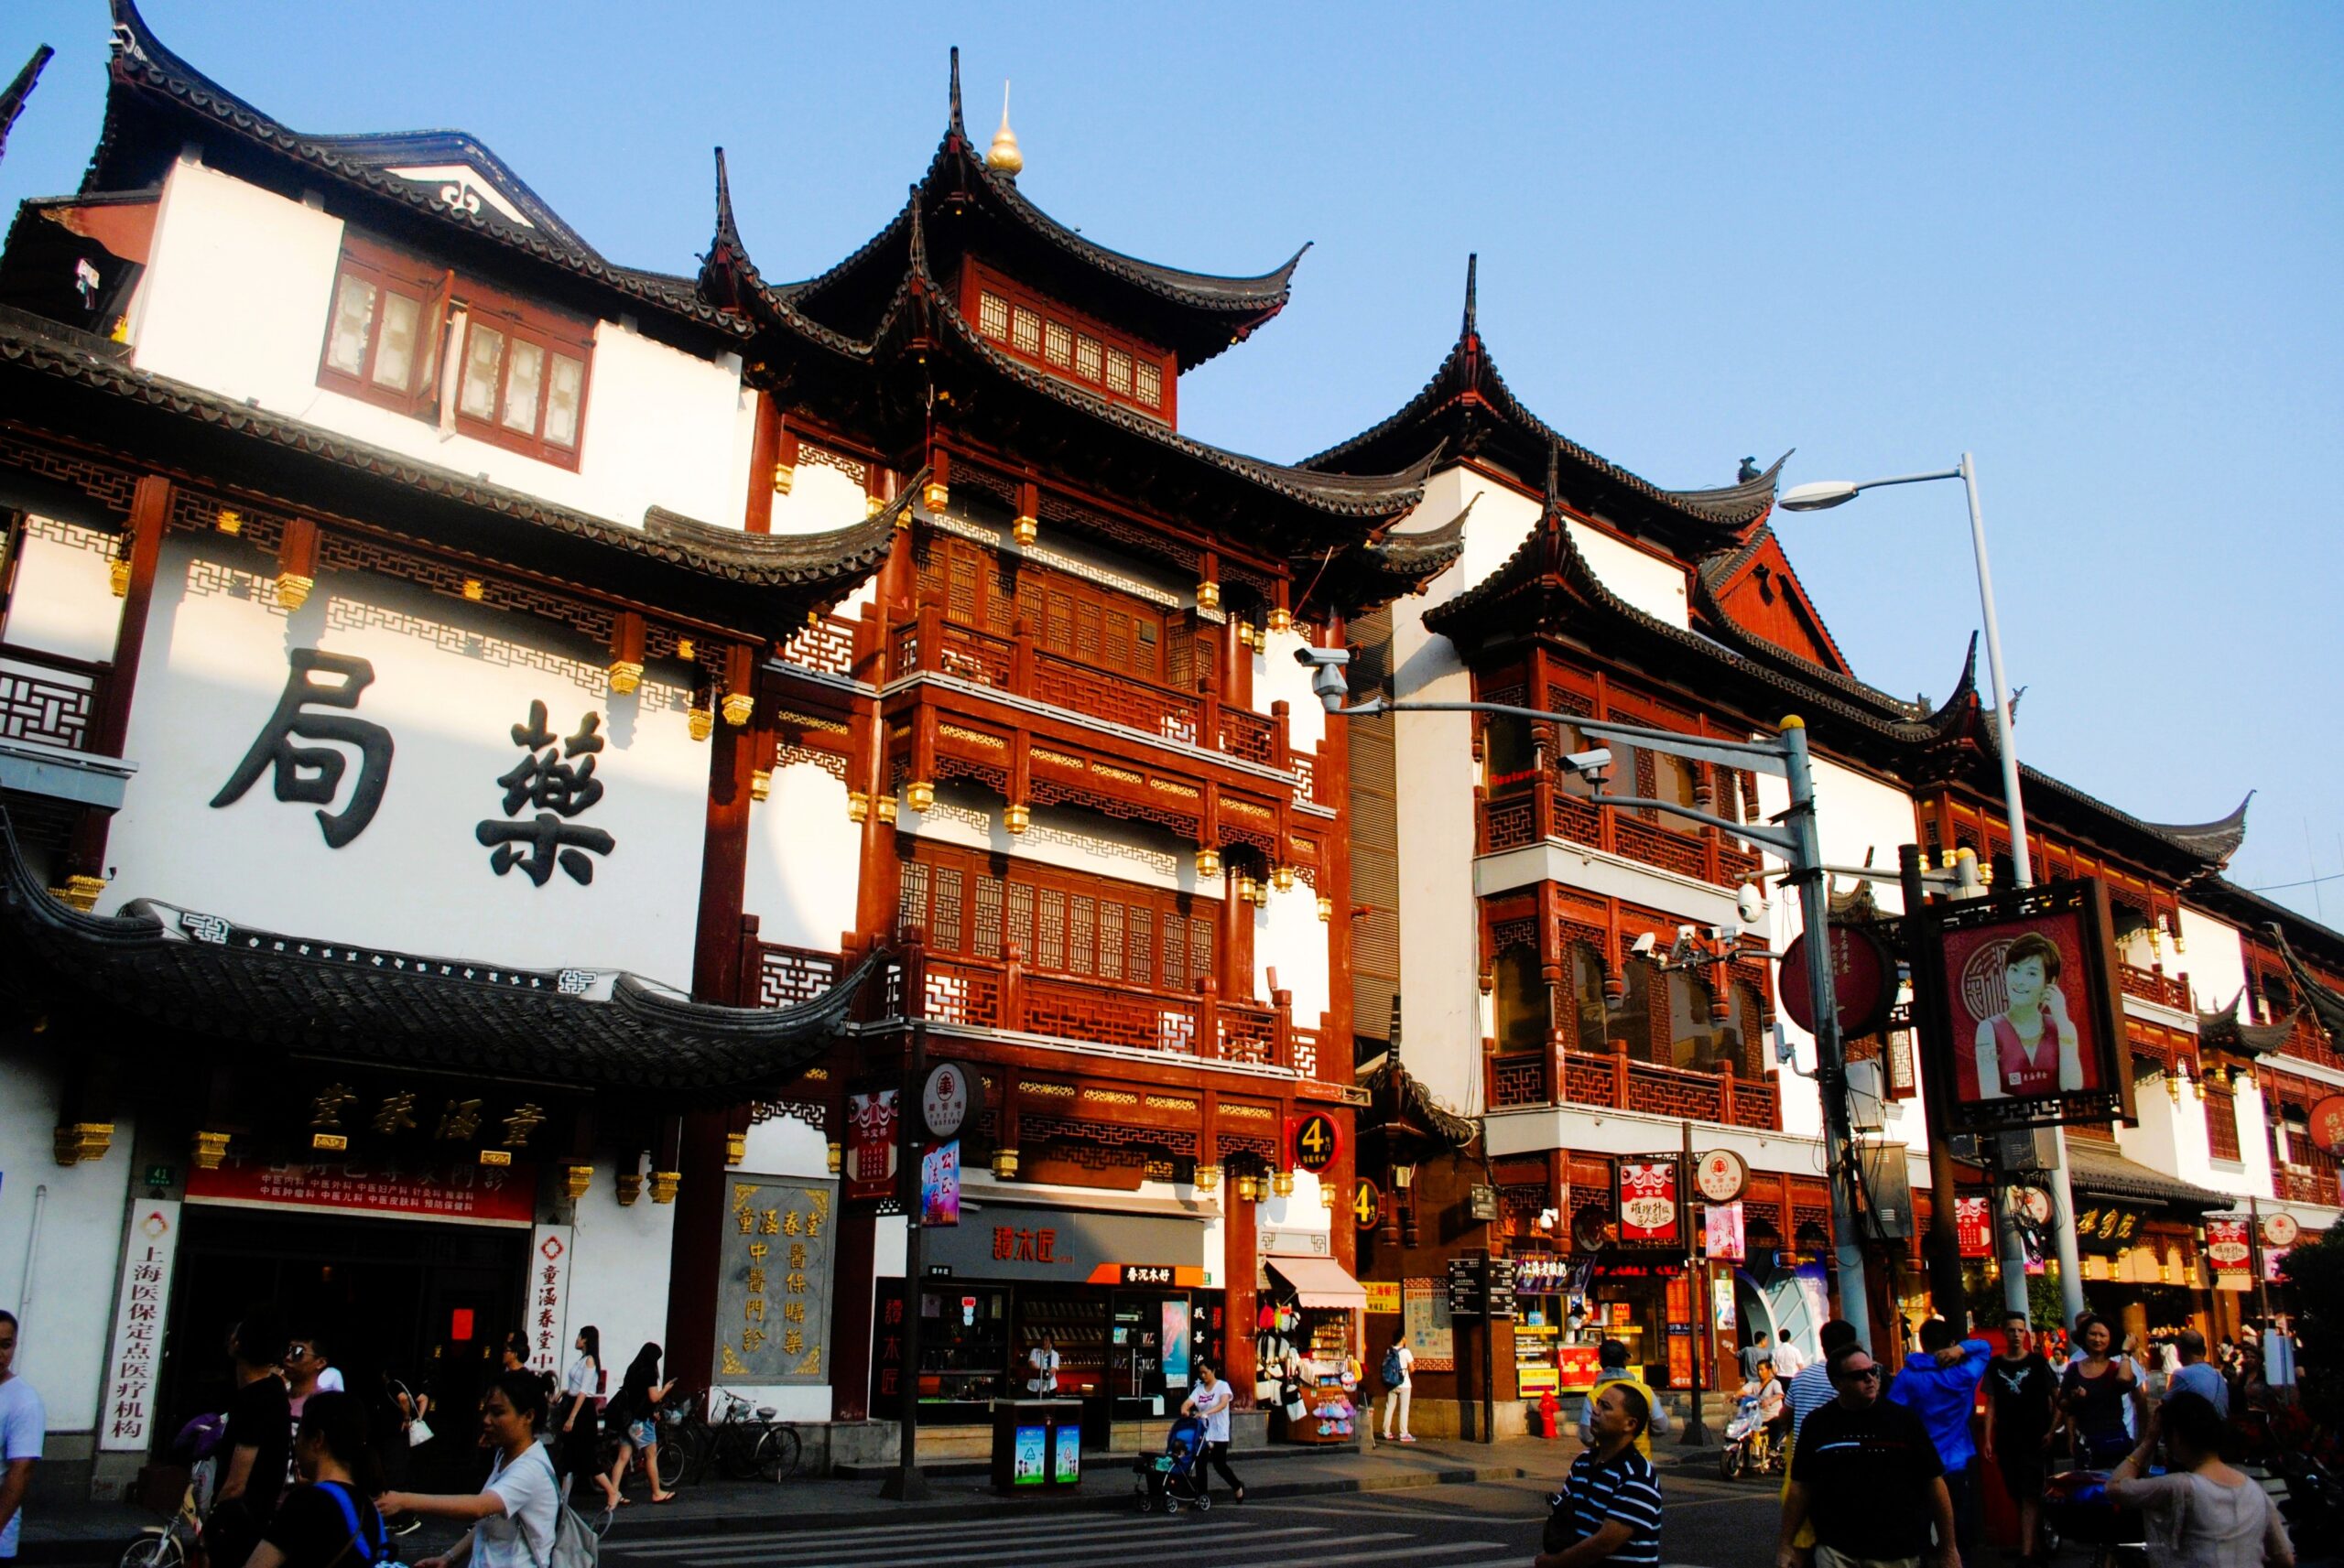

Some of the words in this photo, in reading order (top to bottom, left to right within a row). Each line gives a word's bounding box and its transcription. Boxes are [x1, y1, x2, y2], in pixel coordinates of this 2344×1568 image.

[1302, 1119, 1324, 1152] 4
[154, 1167, 167, 1180] 41
[735, 1206, 822, 1237] 童涵春堂
[1354, 1184, 1370, 1222] 4
[993, 1226, 1057, 1263] 譚木匠
[743, 1240, 768, 1353] 中醫門診
[782, 1243, 808, 1355] 醫保購藥
[111, 1246, 165, 1439] 上海医保定点医疗机构
